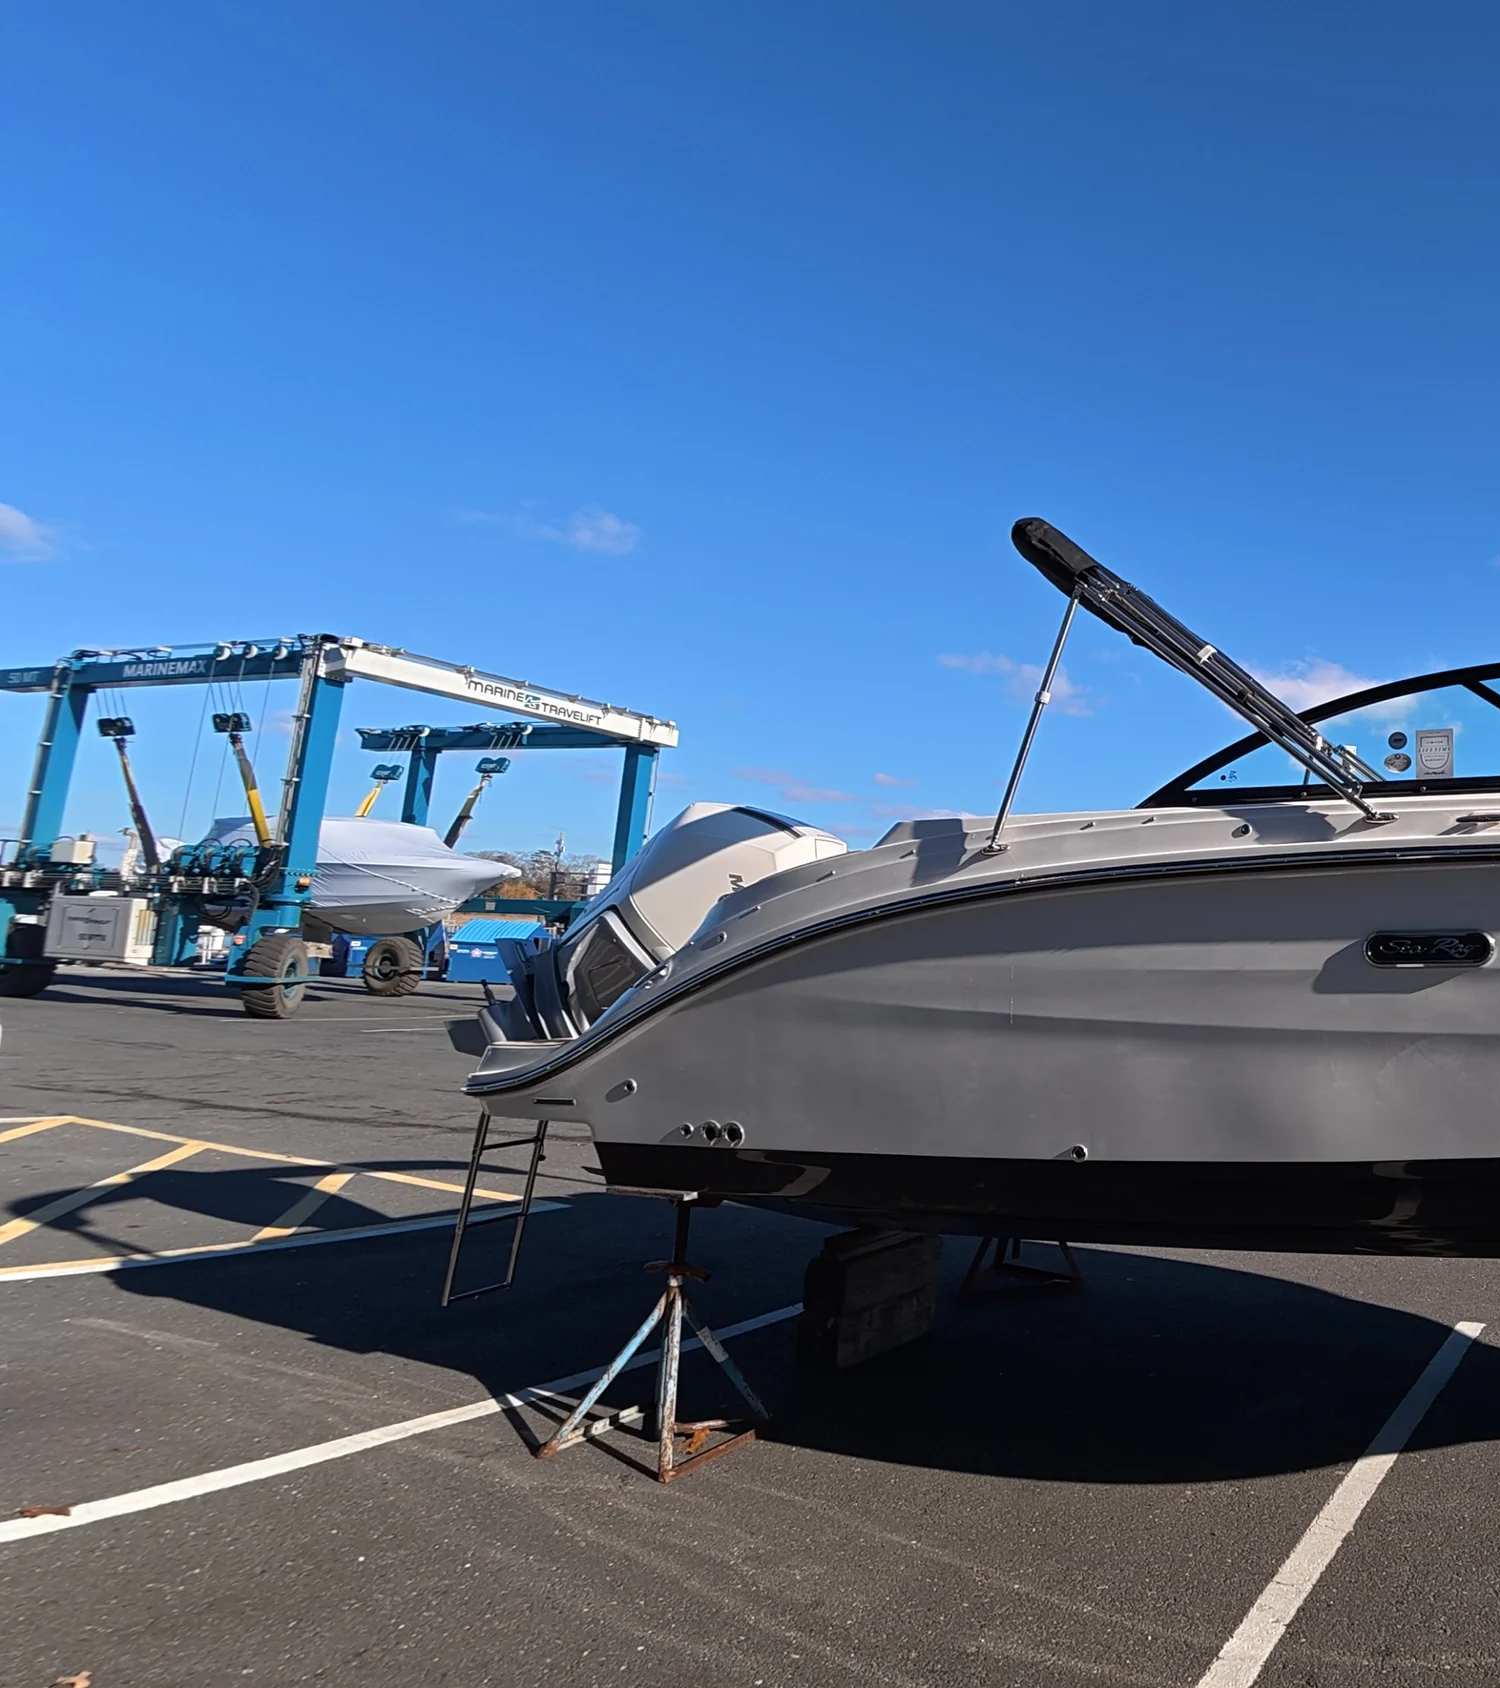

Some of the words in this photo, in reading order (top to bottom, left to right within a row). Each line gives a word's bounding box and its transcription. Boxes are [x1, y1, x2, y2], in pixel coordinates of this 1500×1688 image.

[122, 659, 207, 678] MARINEMAX
[467, 679, 525, 703] MARINE
[541, 702, 602, 725] TRAVELIFT
[1380, 940, 1427, 954] Sea
[1429, 938, 1480, 958] Ray
